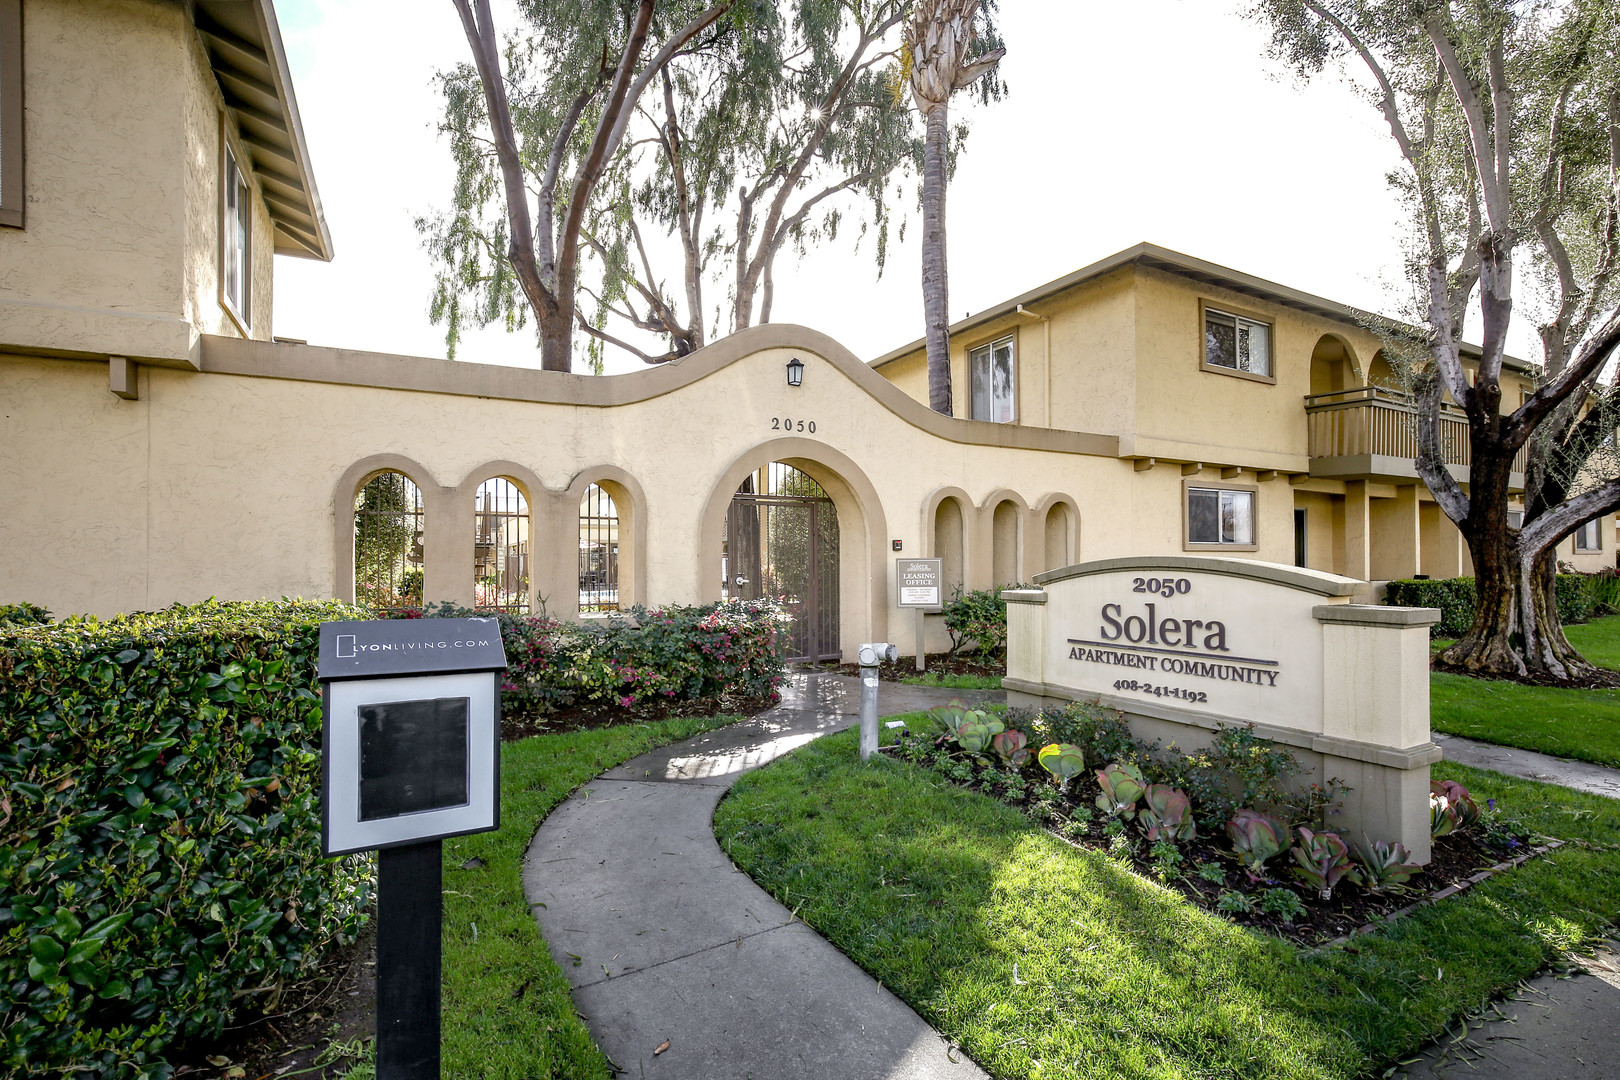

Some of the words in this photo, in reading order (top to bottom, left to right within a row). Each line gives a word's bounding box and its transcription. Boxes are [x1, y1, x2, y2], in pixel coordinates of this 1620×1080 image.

[771, 417, 817, 434] 2050
[1132, 577, 1191, 598] 2050
[1100, 602, 1230, 652] Solera
[353, 639, 489, 653] LYONLIVING.COM
[1069, 646, 1158, 671] APARTMENT
[1160, 657, 1280, 687] COMMUNITY
[1113, 679, 1208, 704] 408-241-1192
